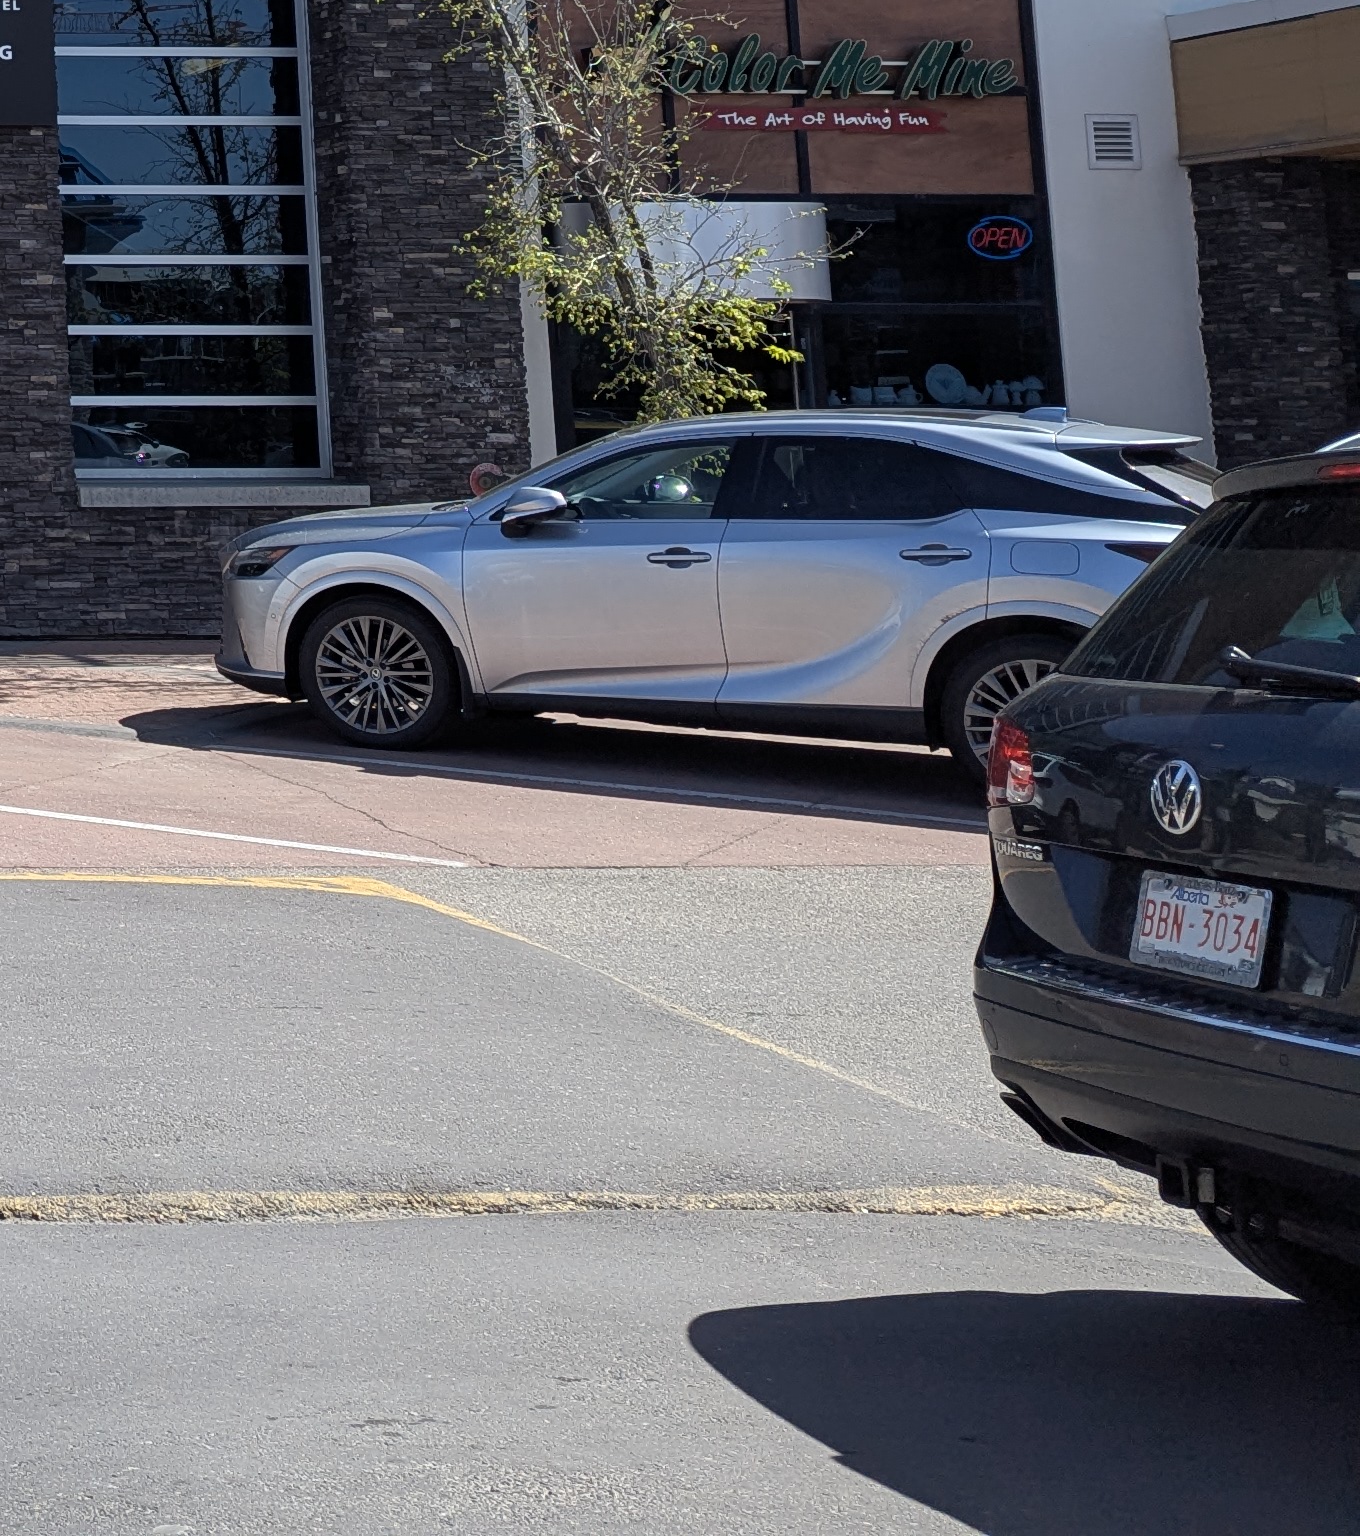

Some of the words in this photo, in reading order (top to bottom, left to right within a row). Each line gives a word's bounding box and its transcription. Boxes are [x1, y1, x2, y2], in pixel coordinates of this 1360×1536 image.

[669, 32, 806, 96] Color
[813, 38, 889, 100] Me
[900, 38, 1018, 100] Mine
[717, 112, 757, 126] The
[764, 112, 794, 127] Art
[801, 112, 826, 126] Of
[833, 112, 892, 129] Having
[898, 112, 930, 126] Fun
[971, 227, 1027, 249] OPEN
[1170, 887, 1210, 906] Alberta
[1140, 898, 1260, 959] BBN-3034
